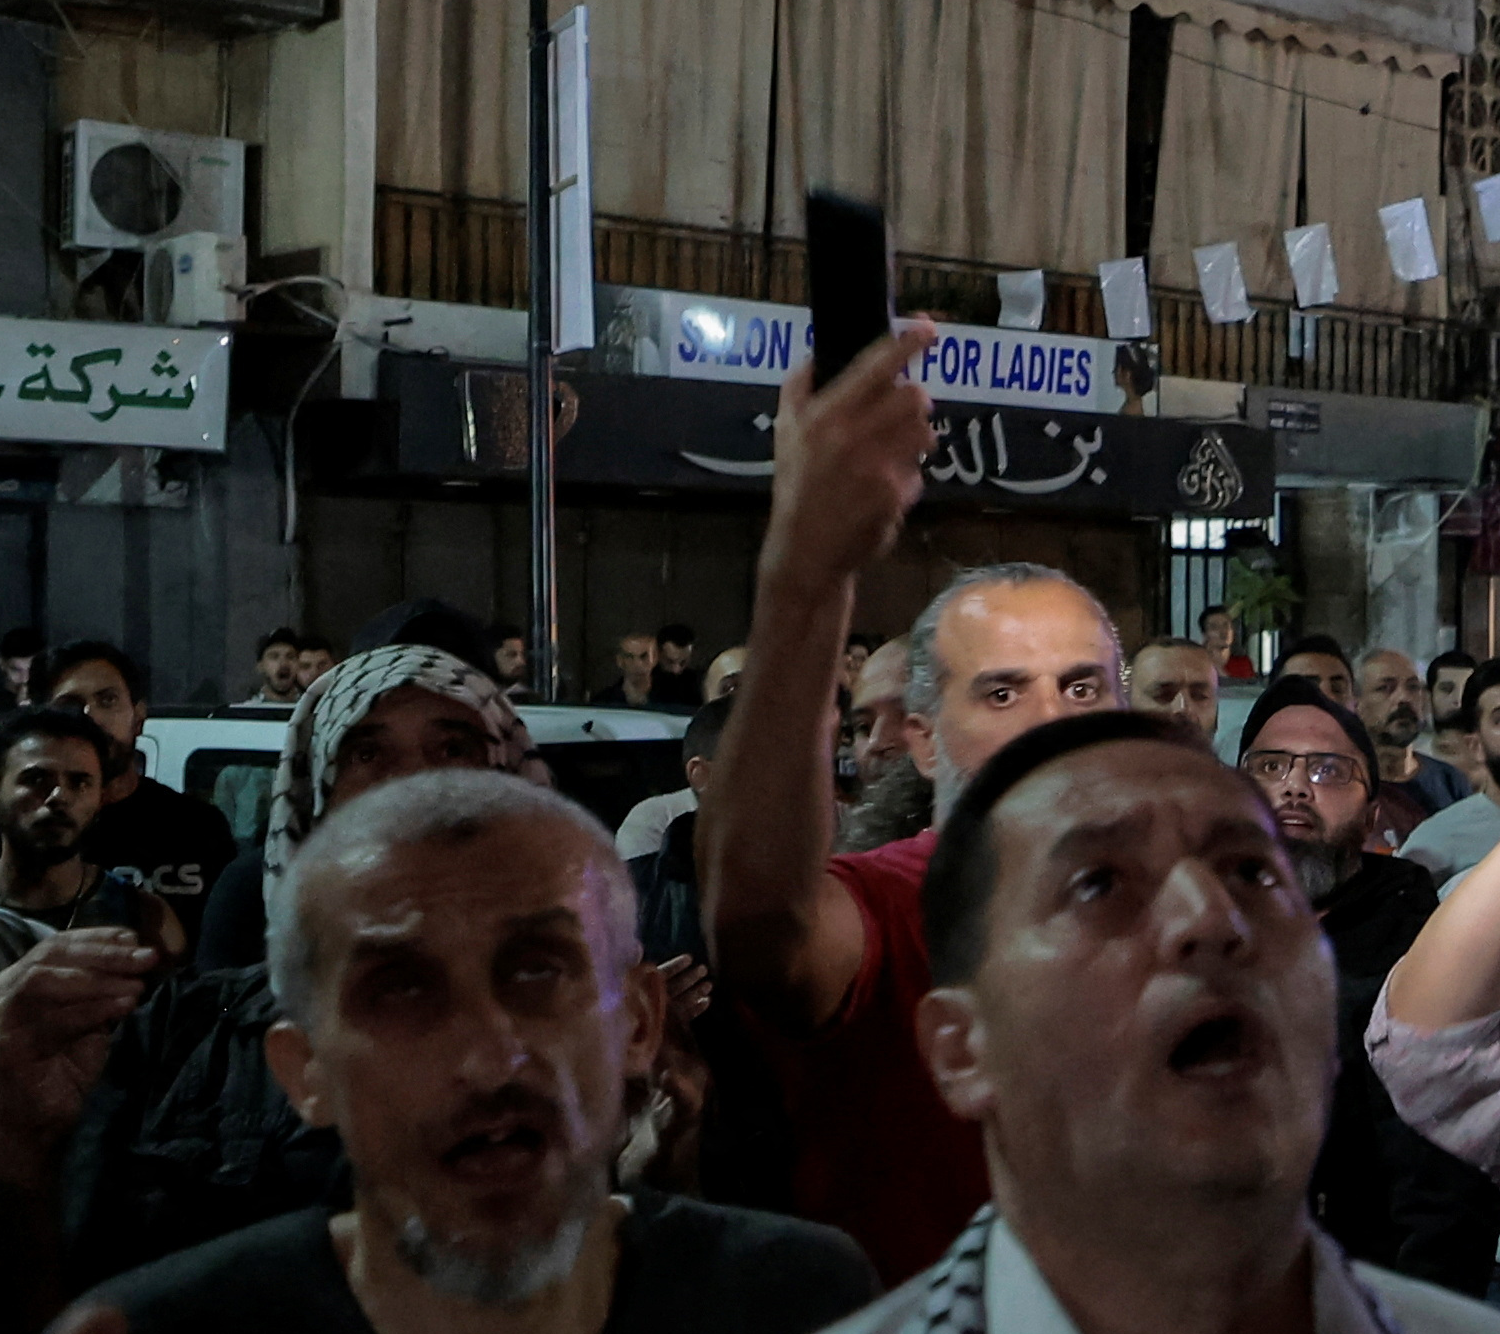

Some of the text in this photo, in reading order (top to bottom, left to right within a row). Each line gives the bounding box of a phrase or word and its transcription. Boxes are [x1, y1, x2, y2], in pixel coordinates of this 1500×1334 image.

[18, 342, 197, 422] شركة
[921, 336, 981, 387] FOR
[990, 341, 1092, 396] LADIES
